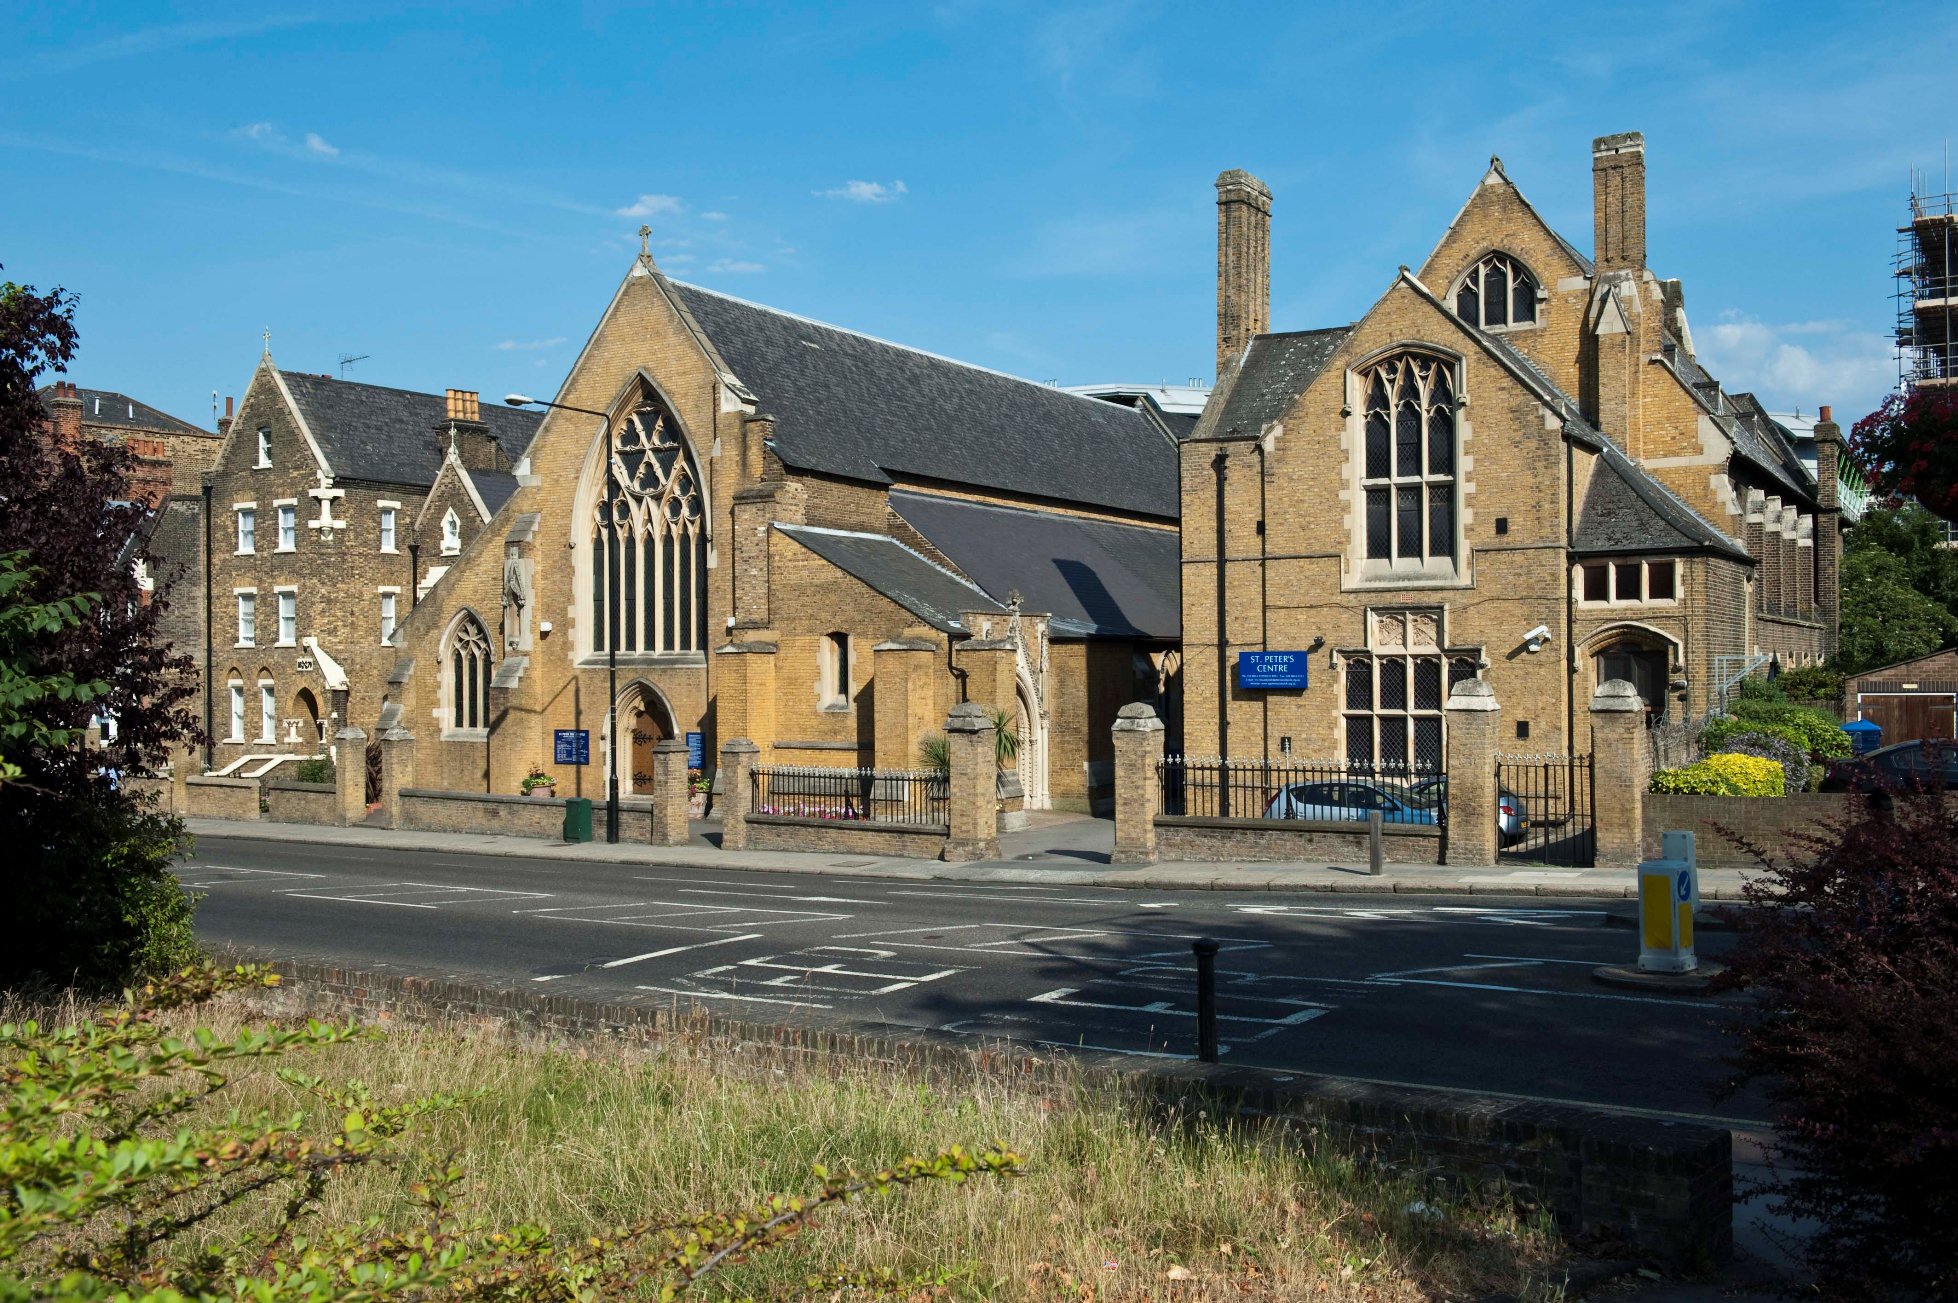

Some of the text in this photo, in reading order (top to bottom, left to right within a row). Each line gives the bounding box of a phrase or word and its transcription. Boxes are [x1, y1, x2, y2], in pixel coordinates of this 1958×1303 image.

[1250, 655, 1294, 663] ST. PETER'S
[1256, 664, 1288, 673] CENTRE
